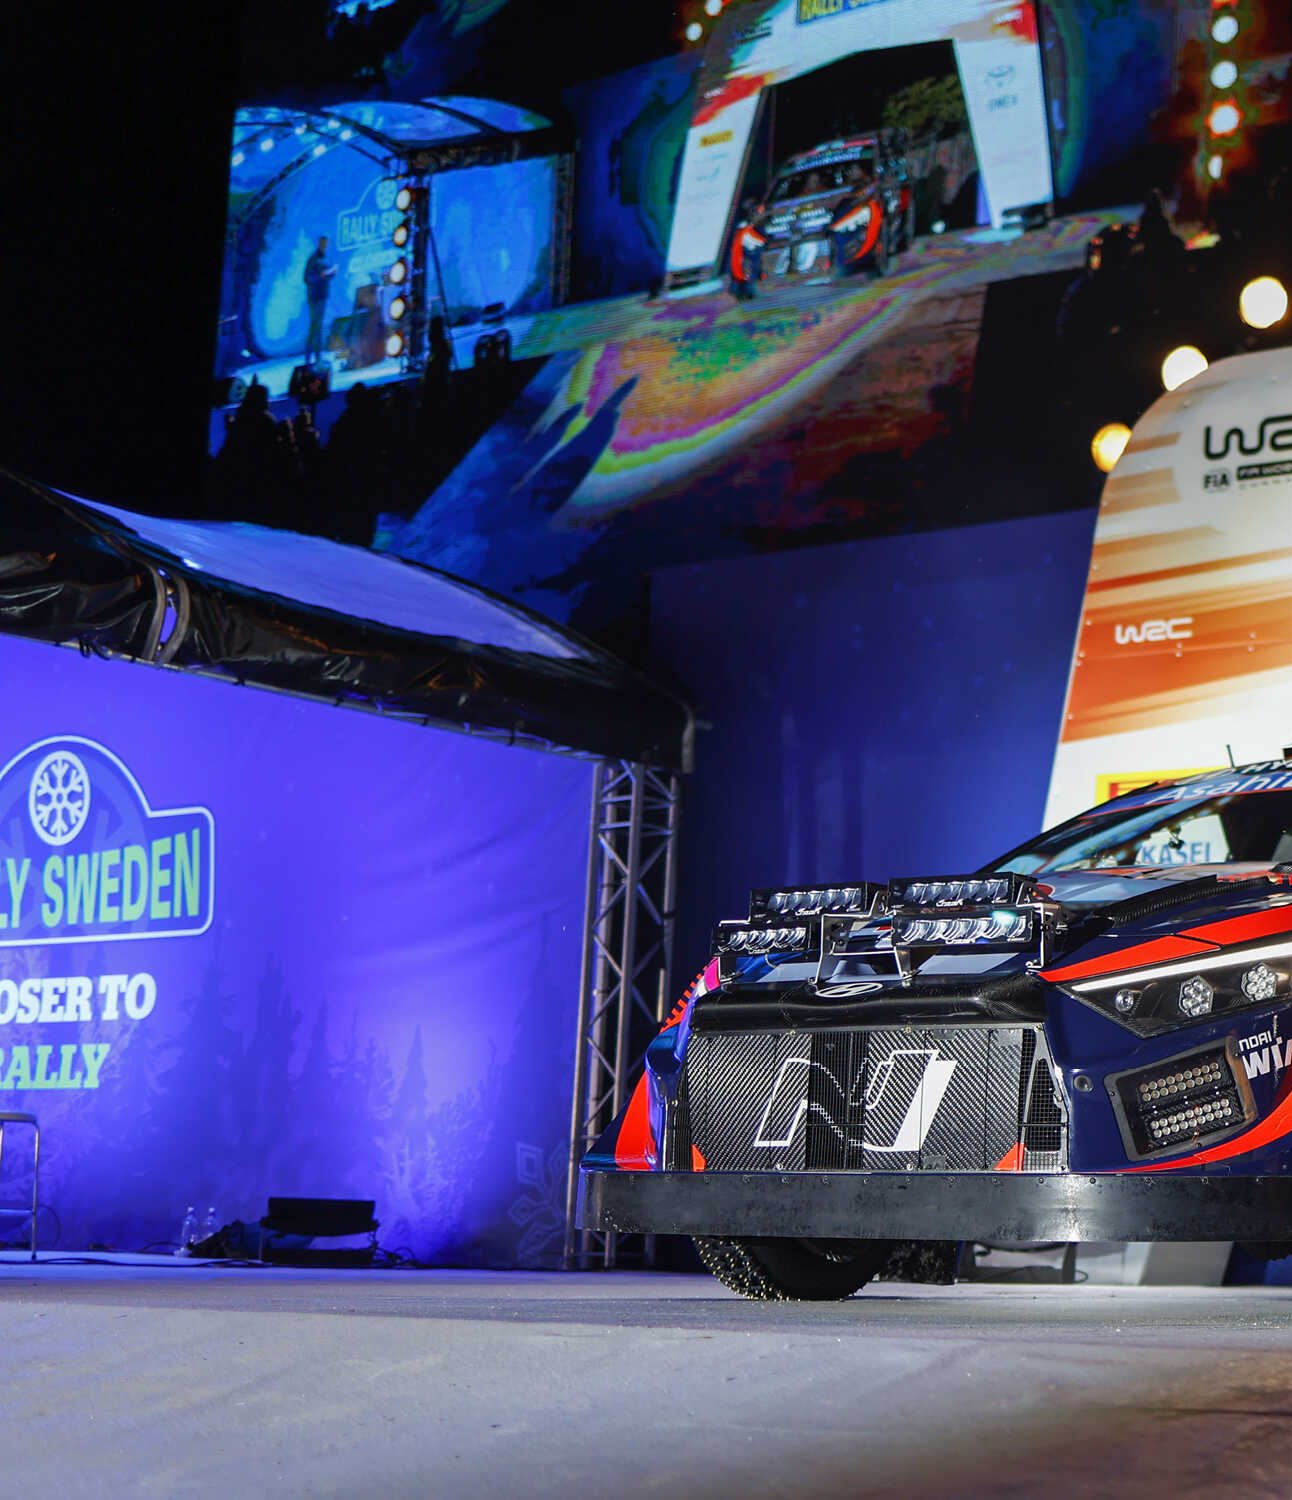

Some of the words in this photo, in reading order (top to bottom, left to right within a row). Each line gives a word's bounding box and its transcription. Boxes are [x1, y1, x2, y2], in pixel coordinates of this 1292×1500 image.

[1114, 616, 1194, 645] WRC
[41, 828, 200, 927] SWEDEN
[99, 972, 157, 1020] TO
